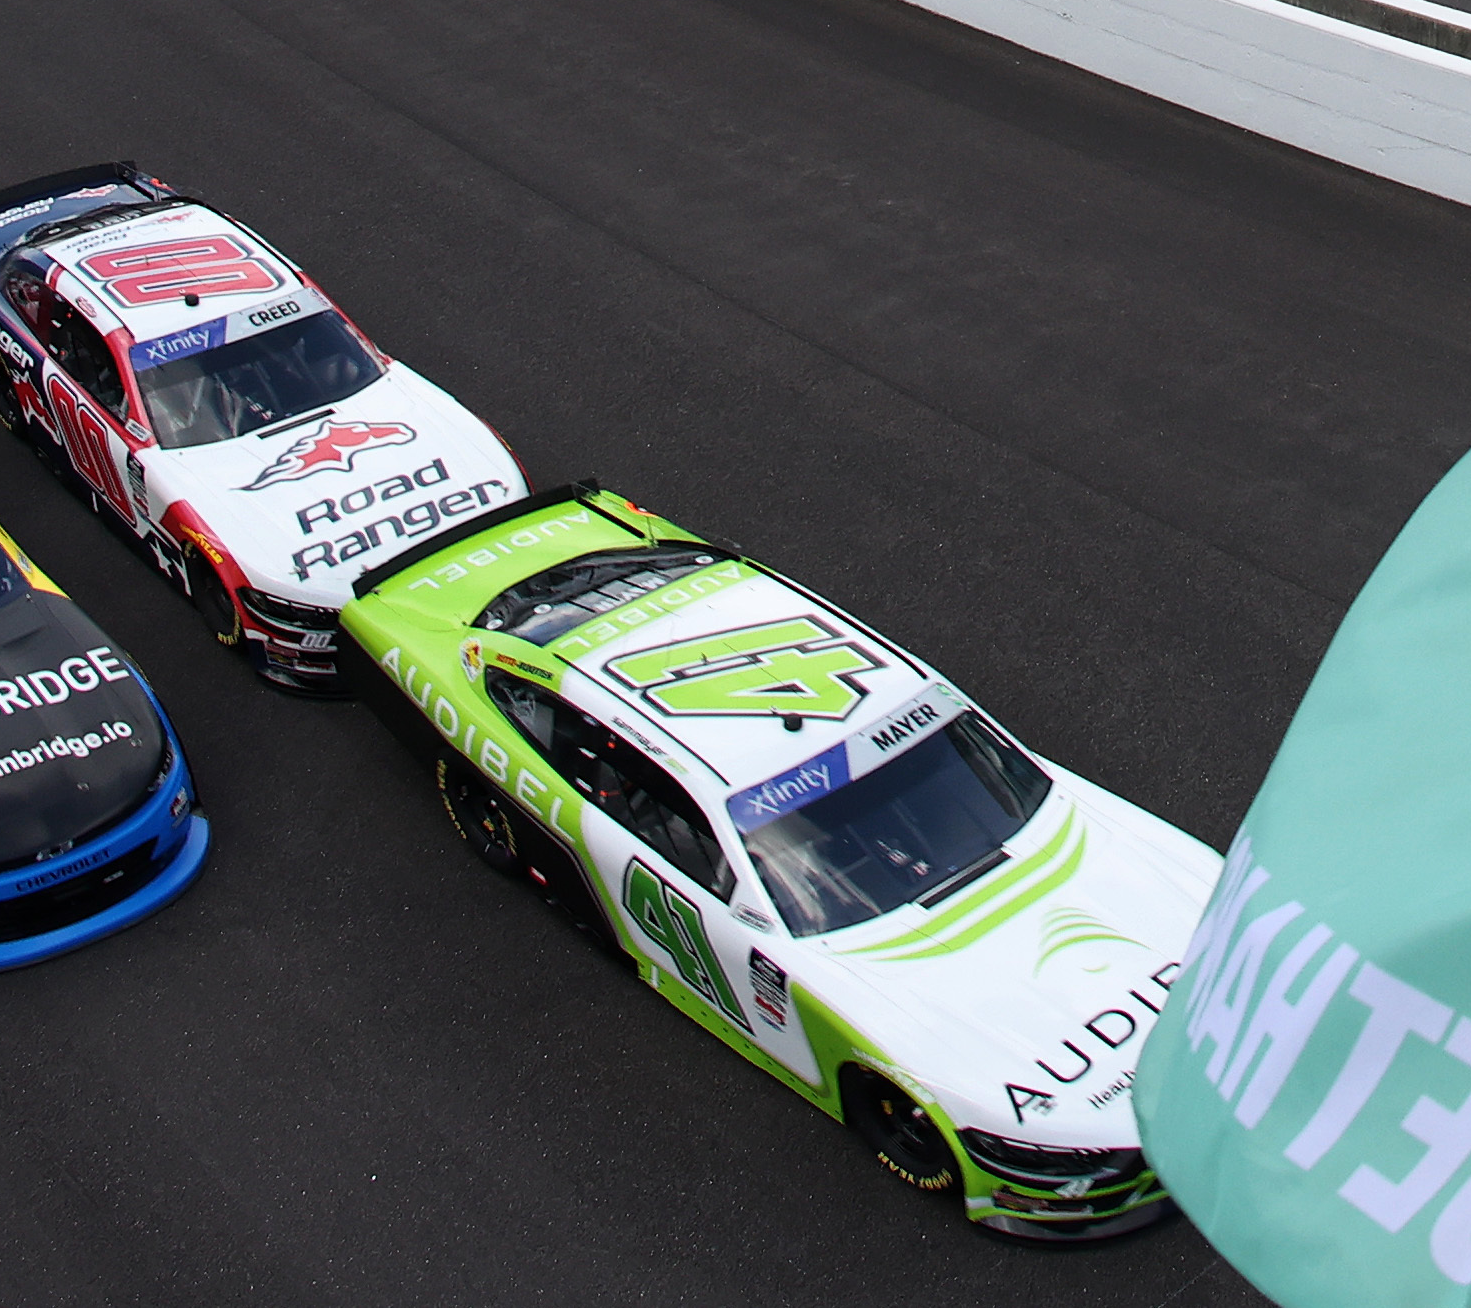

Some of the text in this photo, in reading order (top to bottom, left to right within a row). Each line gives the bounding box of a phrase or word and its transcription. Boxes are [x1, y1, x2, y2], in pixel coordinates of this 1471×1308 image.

[76, 234, 286, 309] 00
[144, 299, 302, 362] xfinity CREED
[289, 480, 511, 584] Ranger
[294, 457, 451, 535] Road
[408, 510, 591, 591] AUDIBEL
[300, 634, 332, 649] 00
[558, 565, 742, 649] AUDIBEL
[604, 616, 889, 721] 41
[382, 646, 575, 843] AUDIBEL
[746, 701, 939, 818] xfinity MAYER
[14, 848, 112, 893] CHEVROLET
[622, 855, 756, 1037] 41
